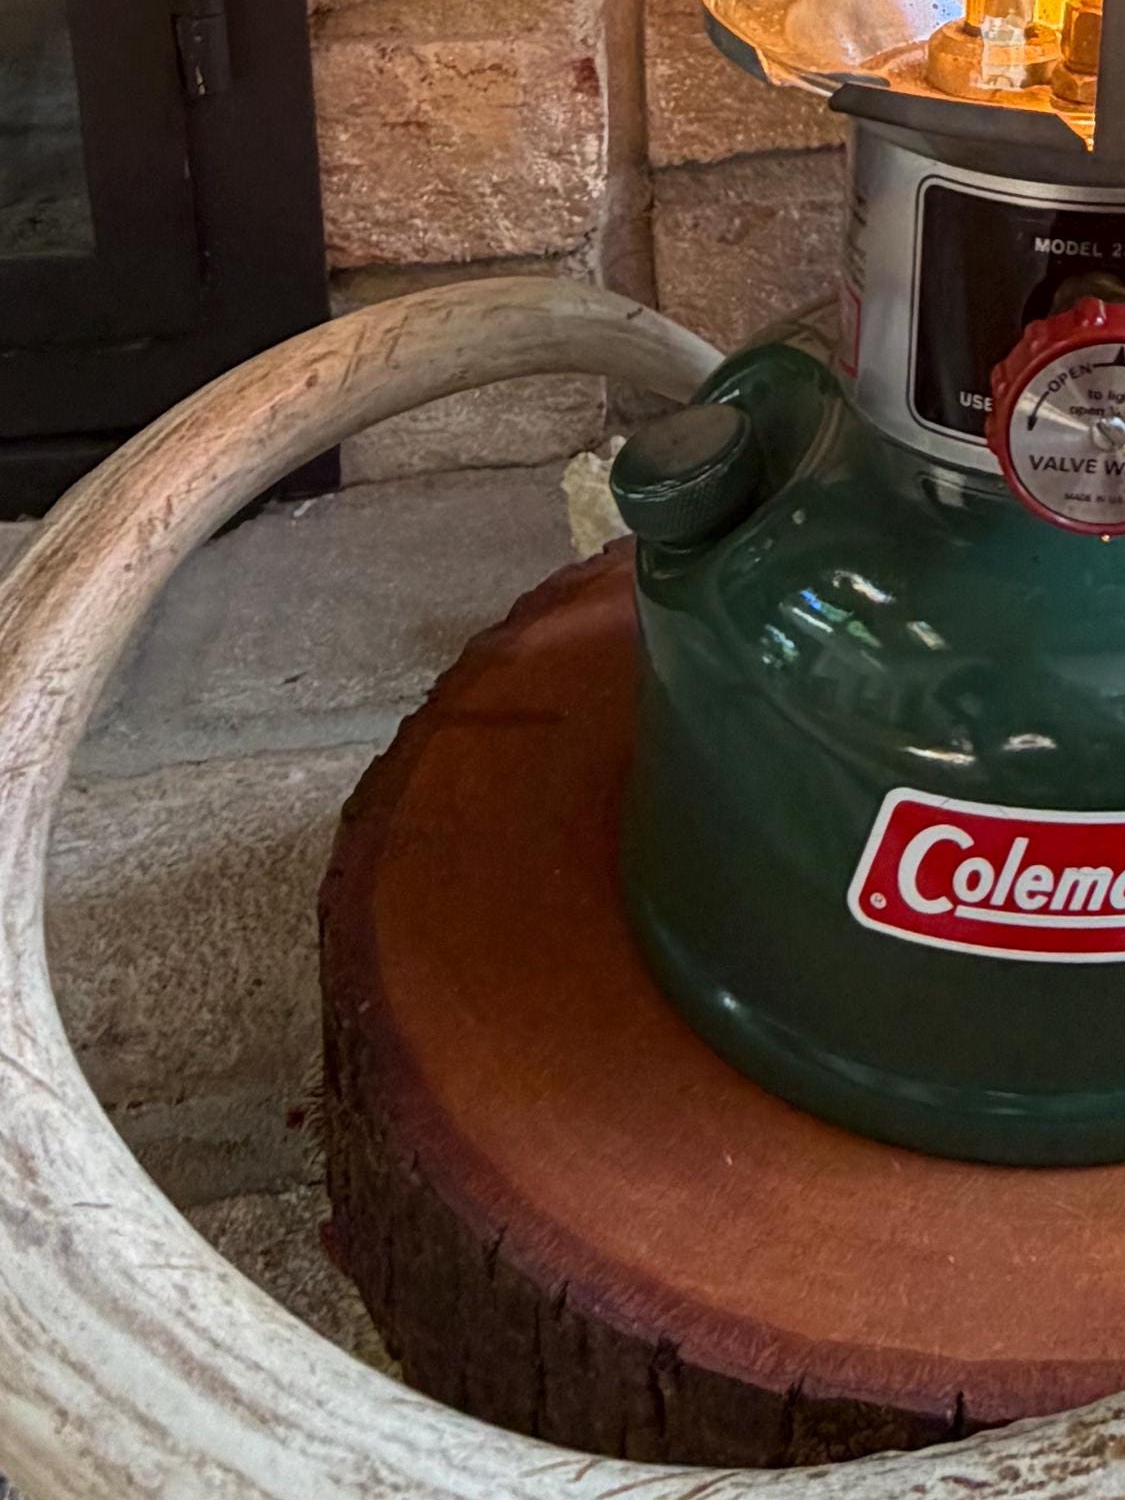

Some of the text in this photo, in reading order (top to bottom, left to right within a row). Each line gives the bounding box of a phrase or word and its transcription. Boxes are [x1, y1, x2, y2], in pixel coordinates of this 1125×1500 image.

[1034, 237, 1103, 258] MODEL
[1048, 362, 1093, 393] OPEN
[960, 391, 993, 412] USE
[1088, 389, 1103, 400] to
[1069, 405, 1105, 417] open
[1029, 455, 1097, 474] VALVE
